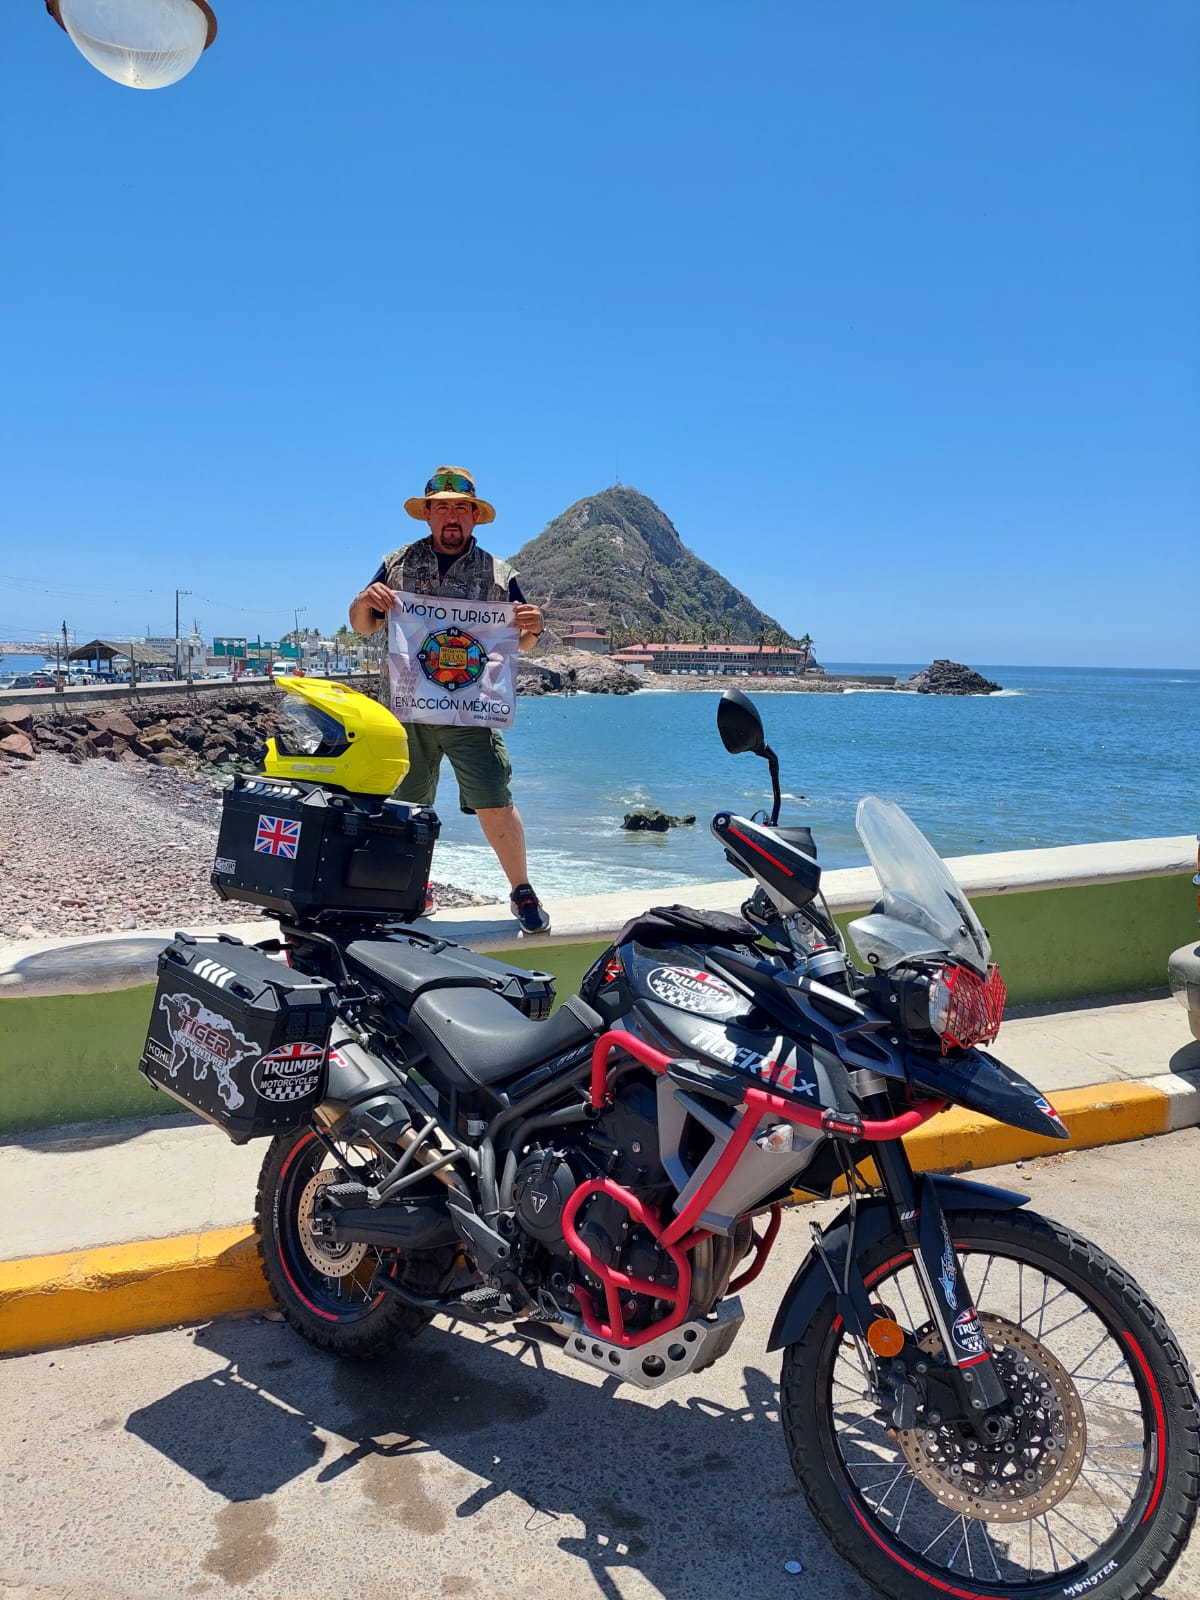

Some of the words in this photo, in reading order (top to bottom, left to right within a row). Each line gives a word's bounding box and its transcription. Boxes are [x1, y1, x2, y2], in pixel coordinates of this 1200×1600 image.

[402, 602, 447, 620] MOTO
[451, 609, 506, 624] TURISTA
[395, 696, 409, 708] EN
[411, 695, 459, 710] ACCIÓN
[462, 697, 511, 715] MÉXICO
[661, 969, 730, 1002] TRIUMPH
[179, 1011, 231, 1064] TIGER
[179, 1035, 226, 1070] ADVENTURE
[262, 1056, 322, 1076] TRIUMPH
[260, 1075, 319, 1089] MOTORCYCLES
[1062, 1559, 1119, 1597] MONSTER
